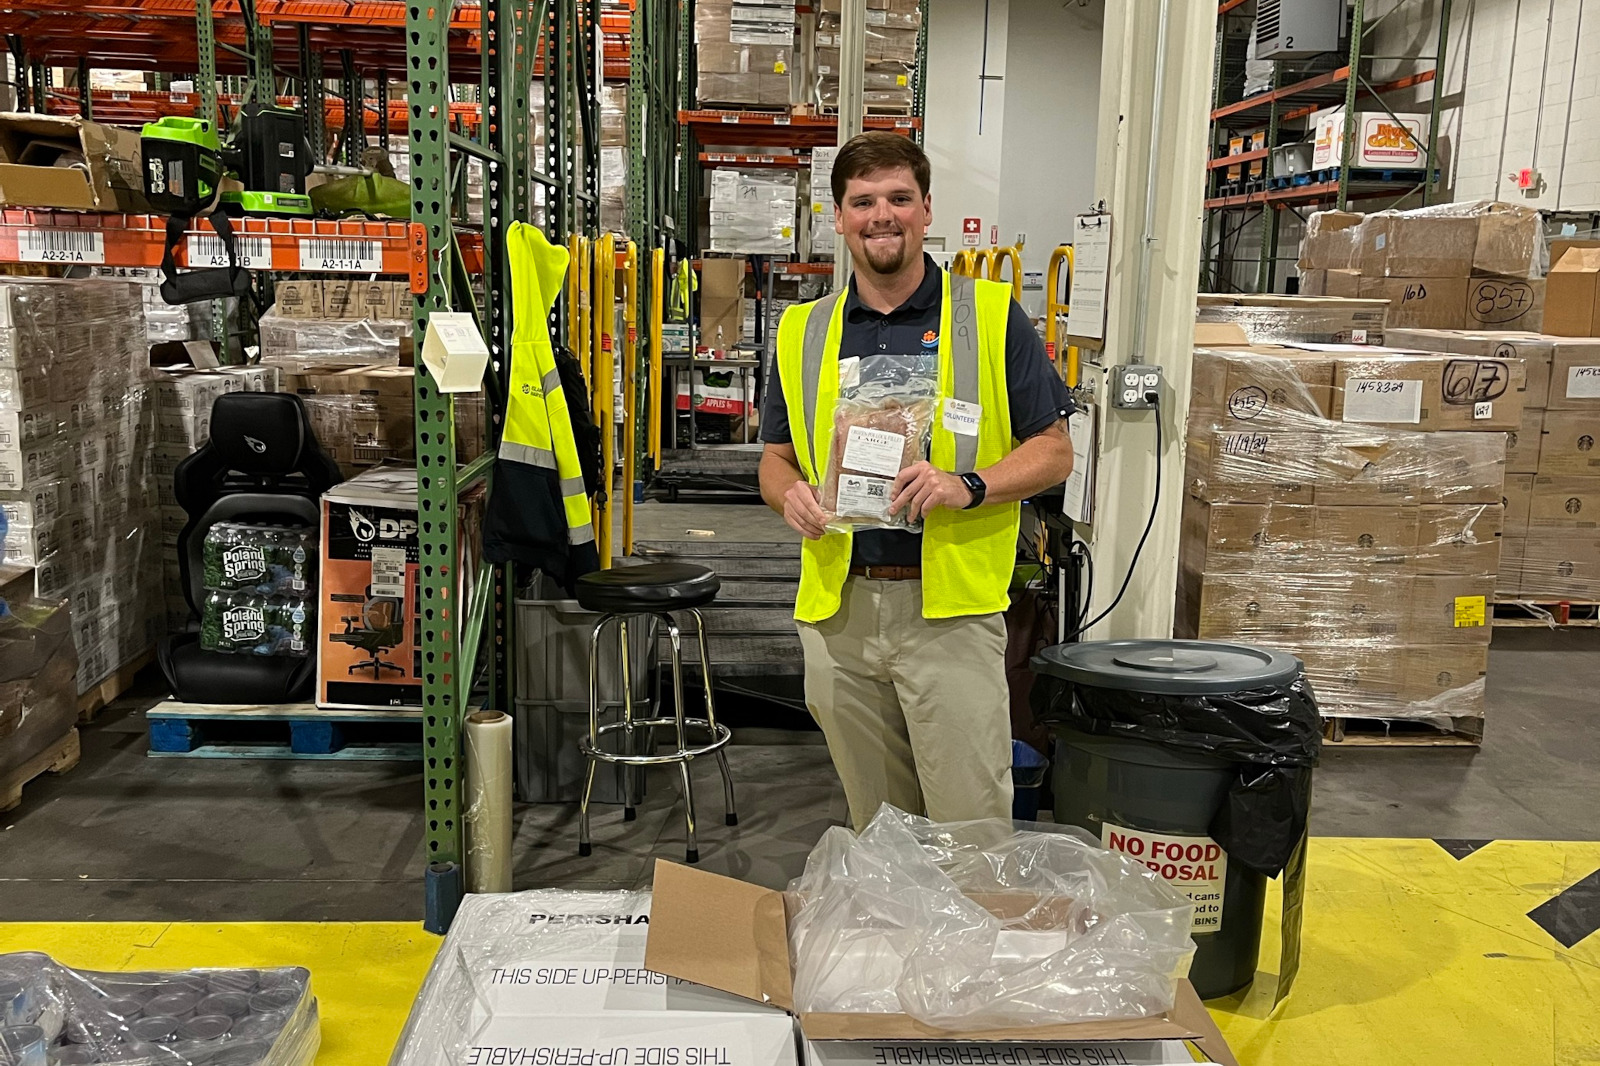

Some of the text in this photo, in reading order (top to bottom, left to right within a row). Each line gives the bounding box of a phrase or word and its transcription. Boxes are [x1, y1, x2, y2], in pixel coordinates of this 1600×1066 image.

[1286, 36, 1294, 49] 2
[42, 251, 83, 262] A2-2-1A
[210, 255, 251, 266] A2-1B
[321, 259, 362, 270] A2-1-1A
[1402, 284, 1427, 304] 16D
[1476, 285, 1527, 314] 857
[1355, 381, 1404, 393] 1458329
[706, 399, 726, 408] APPLES
[1225, 432, 1268, 454] 11/19/24
[380, 518, 418, 540] DP
[223, 546, 265, 565] Poland
[224, 559, 266, 578] Spring
[223, 607, 265, 625] Poland
[223, 620, 265, 638] Spring
[1109, 831, 1221, 862] NO FOOD
[1194, 893, 1220, 901] cans
[1208, 904, 1219, 912] to
[529, 914, 650, 925] PERISHA
[1194, 917, 1218, 925] BINS
[491, 968, 532, 985] THIS
[535, 968, 578, 985] SIDE
[467, 1047, 731, 1066] THIS SIDE UP-PERISHABLE
[873, 1046, 1133, 1066] THIS SIDE UP-PERISHABLE
